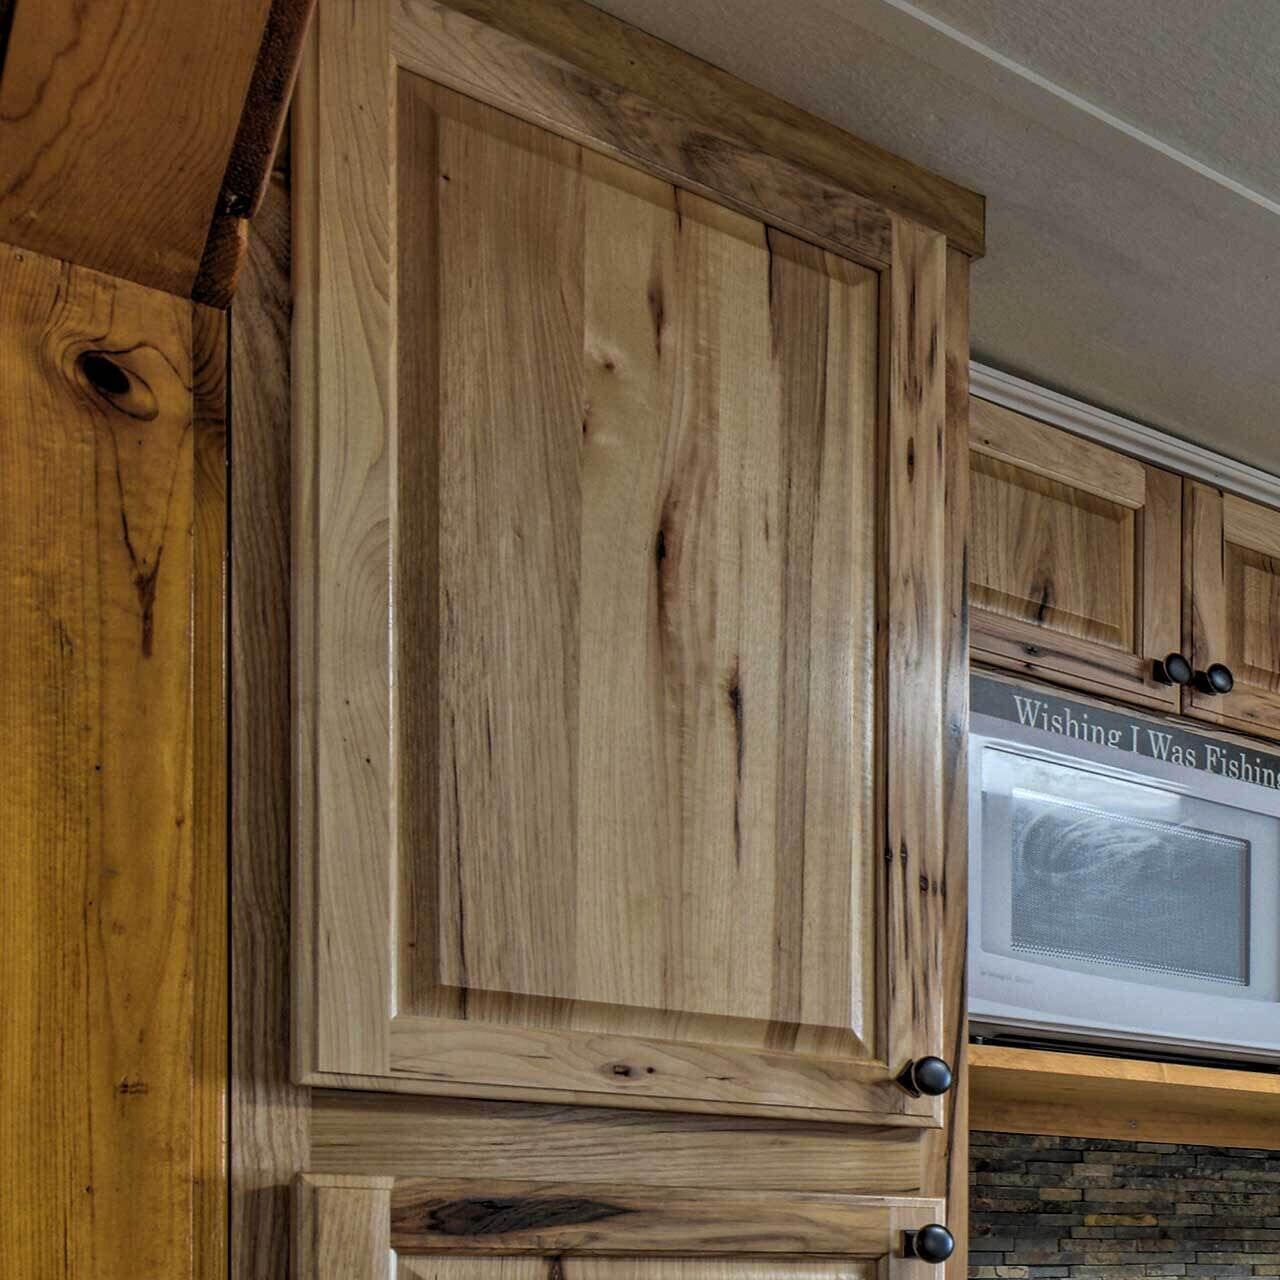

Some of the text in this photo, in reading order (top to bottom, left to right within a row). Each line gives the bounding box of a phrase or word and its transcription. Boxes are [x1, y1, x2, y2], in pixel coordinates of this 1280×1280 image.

[1013, 695, 1123, 749] Wishing
[1130, 725, 1141, 753] I
[1147, 729, 1197, 767] Was
